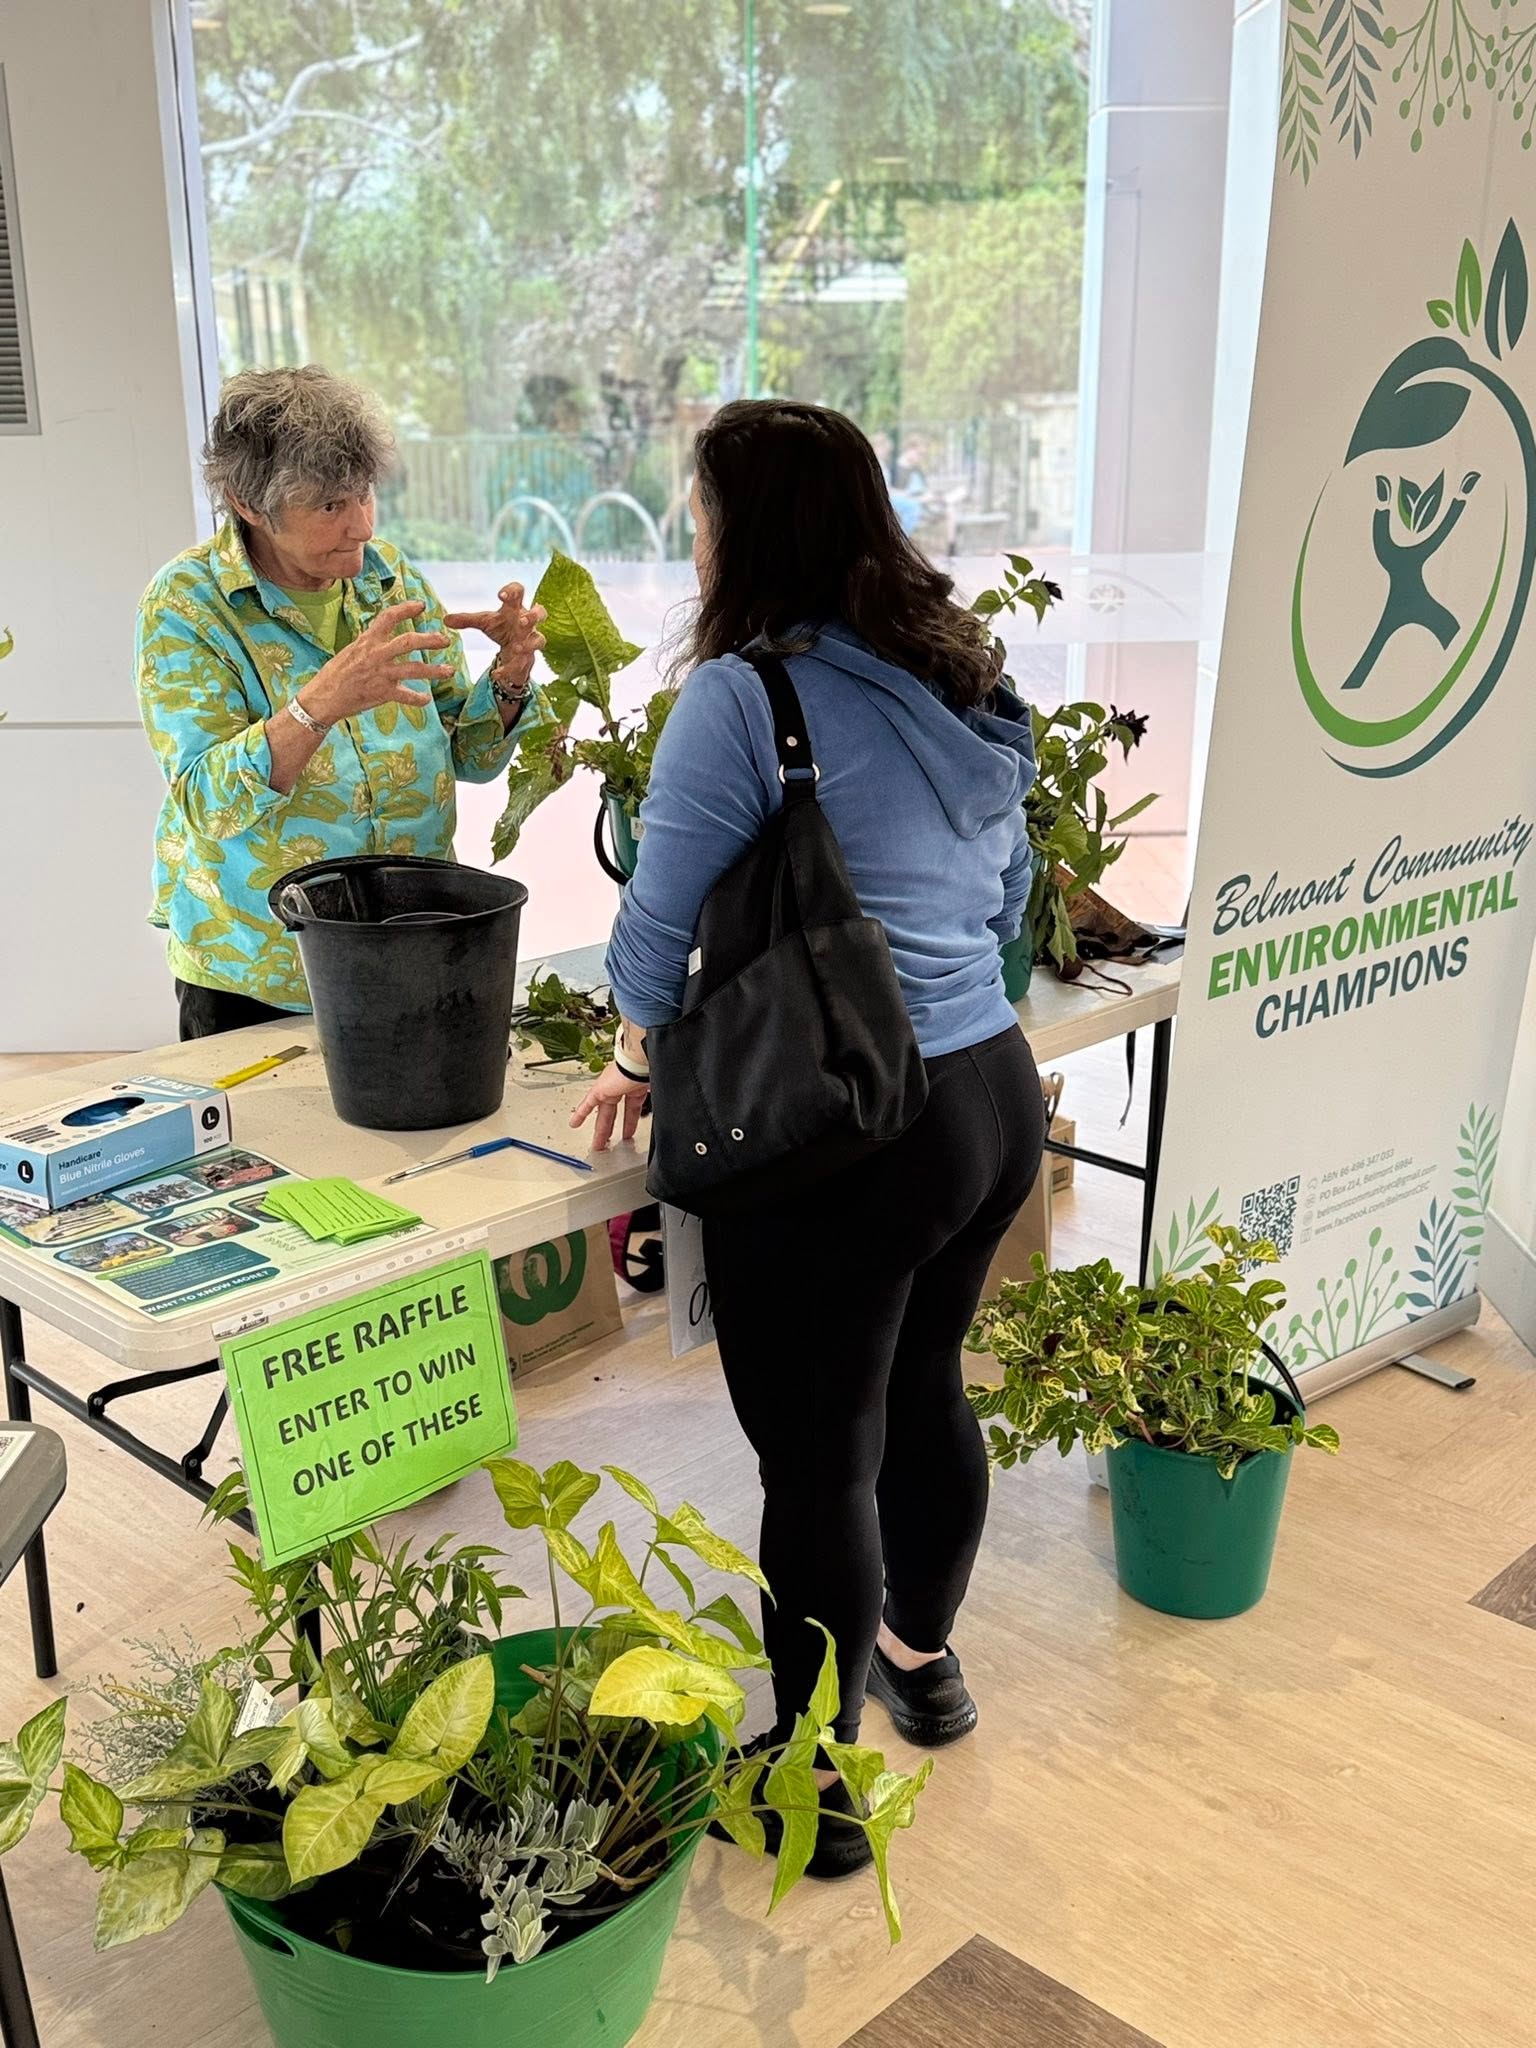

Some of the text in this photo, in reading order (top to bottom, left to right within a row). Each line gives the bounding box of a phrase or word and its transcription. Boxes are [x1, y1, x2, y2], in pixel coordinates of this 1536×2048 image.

[1213, 814, 1534, 936] Belmont Community
[1207, 870, 1518, 1000] ENVIRONMENTAL
[1255, 936, 1469, 1039] CHAMPIONS
[58, 1148, 103, 1170] Handicare
[60, 1169, 82, 1185] Blue
[84, 1159, 112, 1175] Nitrile
[114, 1147, 145, 1164] Gloves
[1320, 1189, 1331, 1200] PO
[1332, 1184, 1346, 1197] Box
[144, 1300, 178, 1313] WANT
[182, 1294, 196, 1303] TO
[197, 1282, 232, 1297] KNOW
[262, 1332, 345, 1390] FREE
[353, 1284, 469, 1354] RAFFLE
[278, 1343, 476, 1445] ENTER TO WIN
[293, 1393, 483, 1496] ONE OF THESE
